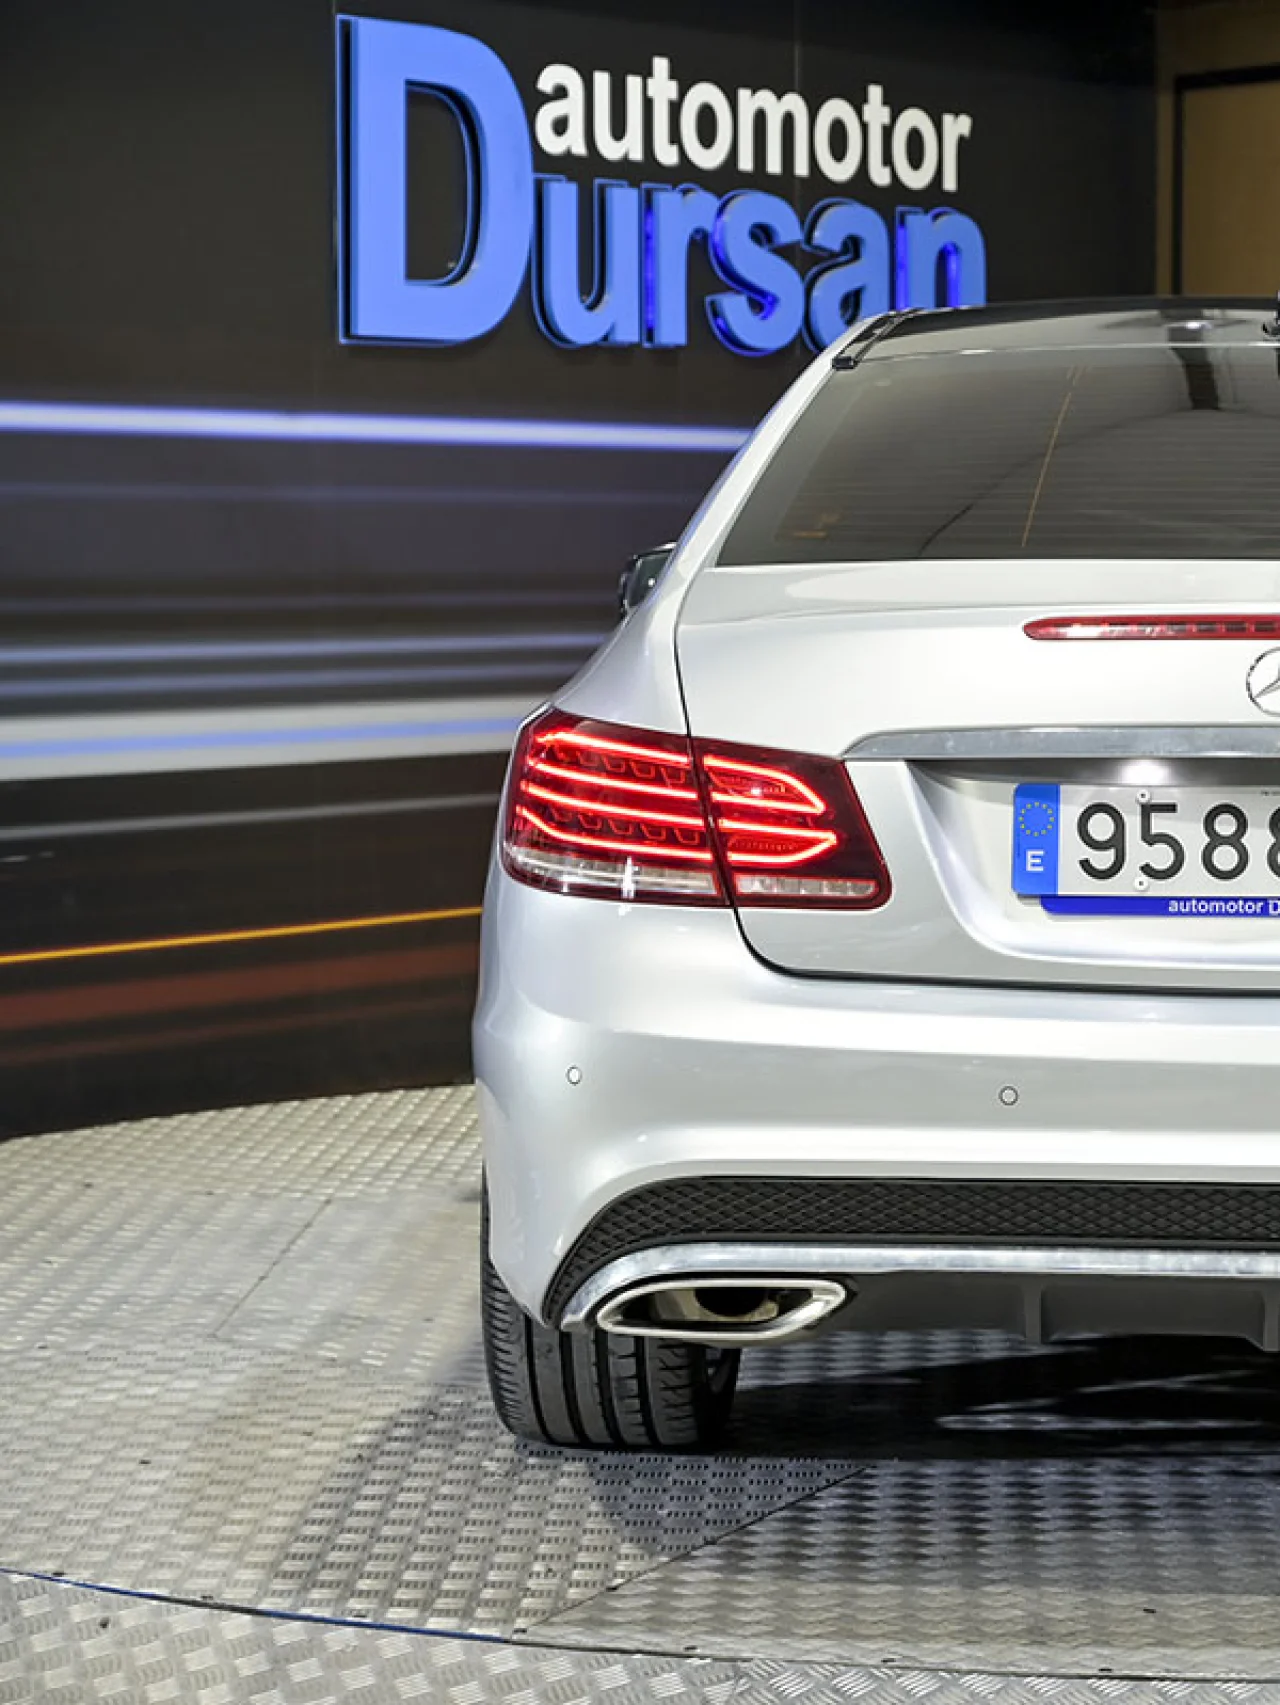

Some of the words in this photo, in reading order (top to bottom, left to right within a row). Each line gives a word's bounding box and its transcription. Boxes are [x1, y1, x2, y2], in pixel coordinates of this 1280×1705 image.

[534, 57, 972, 192] automotor
[336, 13, 987, 358] Dursan
[1026, 850, 1044, 872] E
[1168, 899, 1263, 914] automotor
